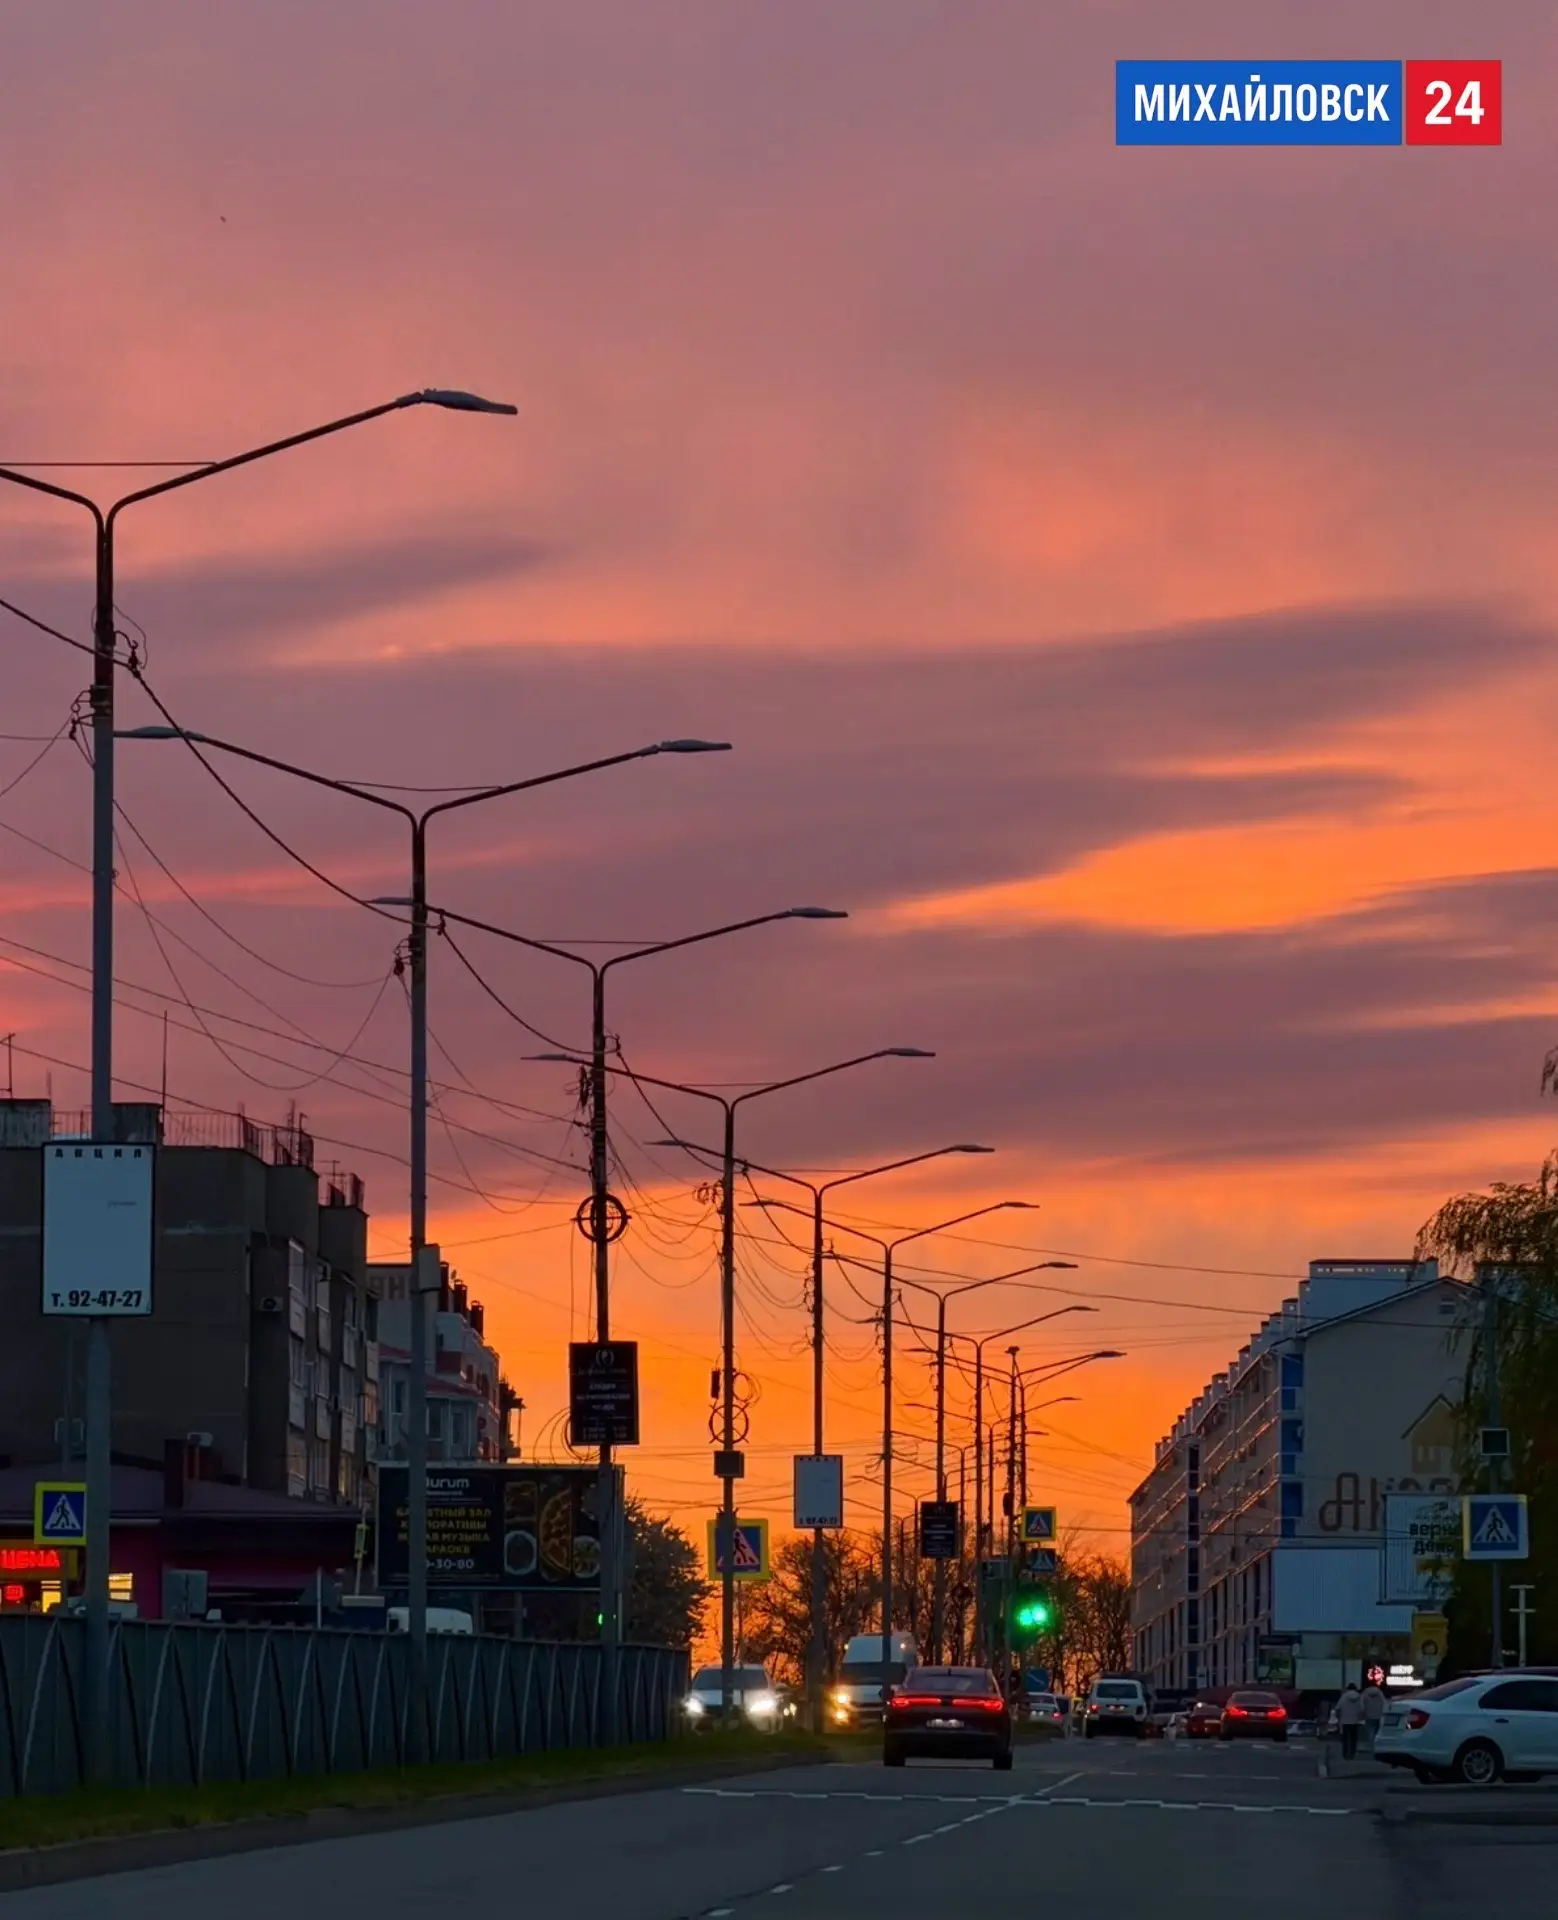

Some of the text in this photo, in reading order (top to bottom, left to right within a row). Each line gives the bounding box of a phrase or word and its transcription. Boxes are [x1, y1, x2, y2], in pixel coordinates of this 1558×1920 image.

[68, 1290, 142, 1308] 92-47-27
[396, 1506, 466, 1517] БАЕТНЫЙ
[399, 1520, 487, 1530] КОРАТИВЫ
[397, 1532, 490, 1542] ЖАЯ МУЗЫКА
[426, 1544, 470, 1554] АРАОКЕ
[424, 1558, 474, 1570] -30-80
